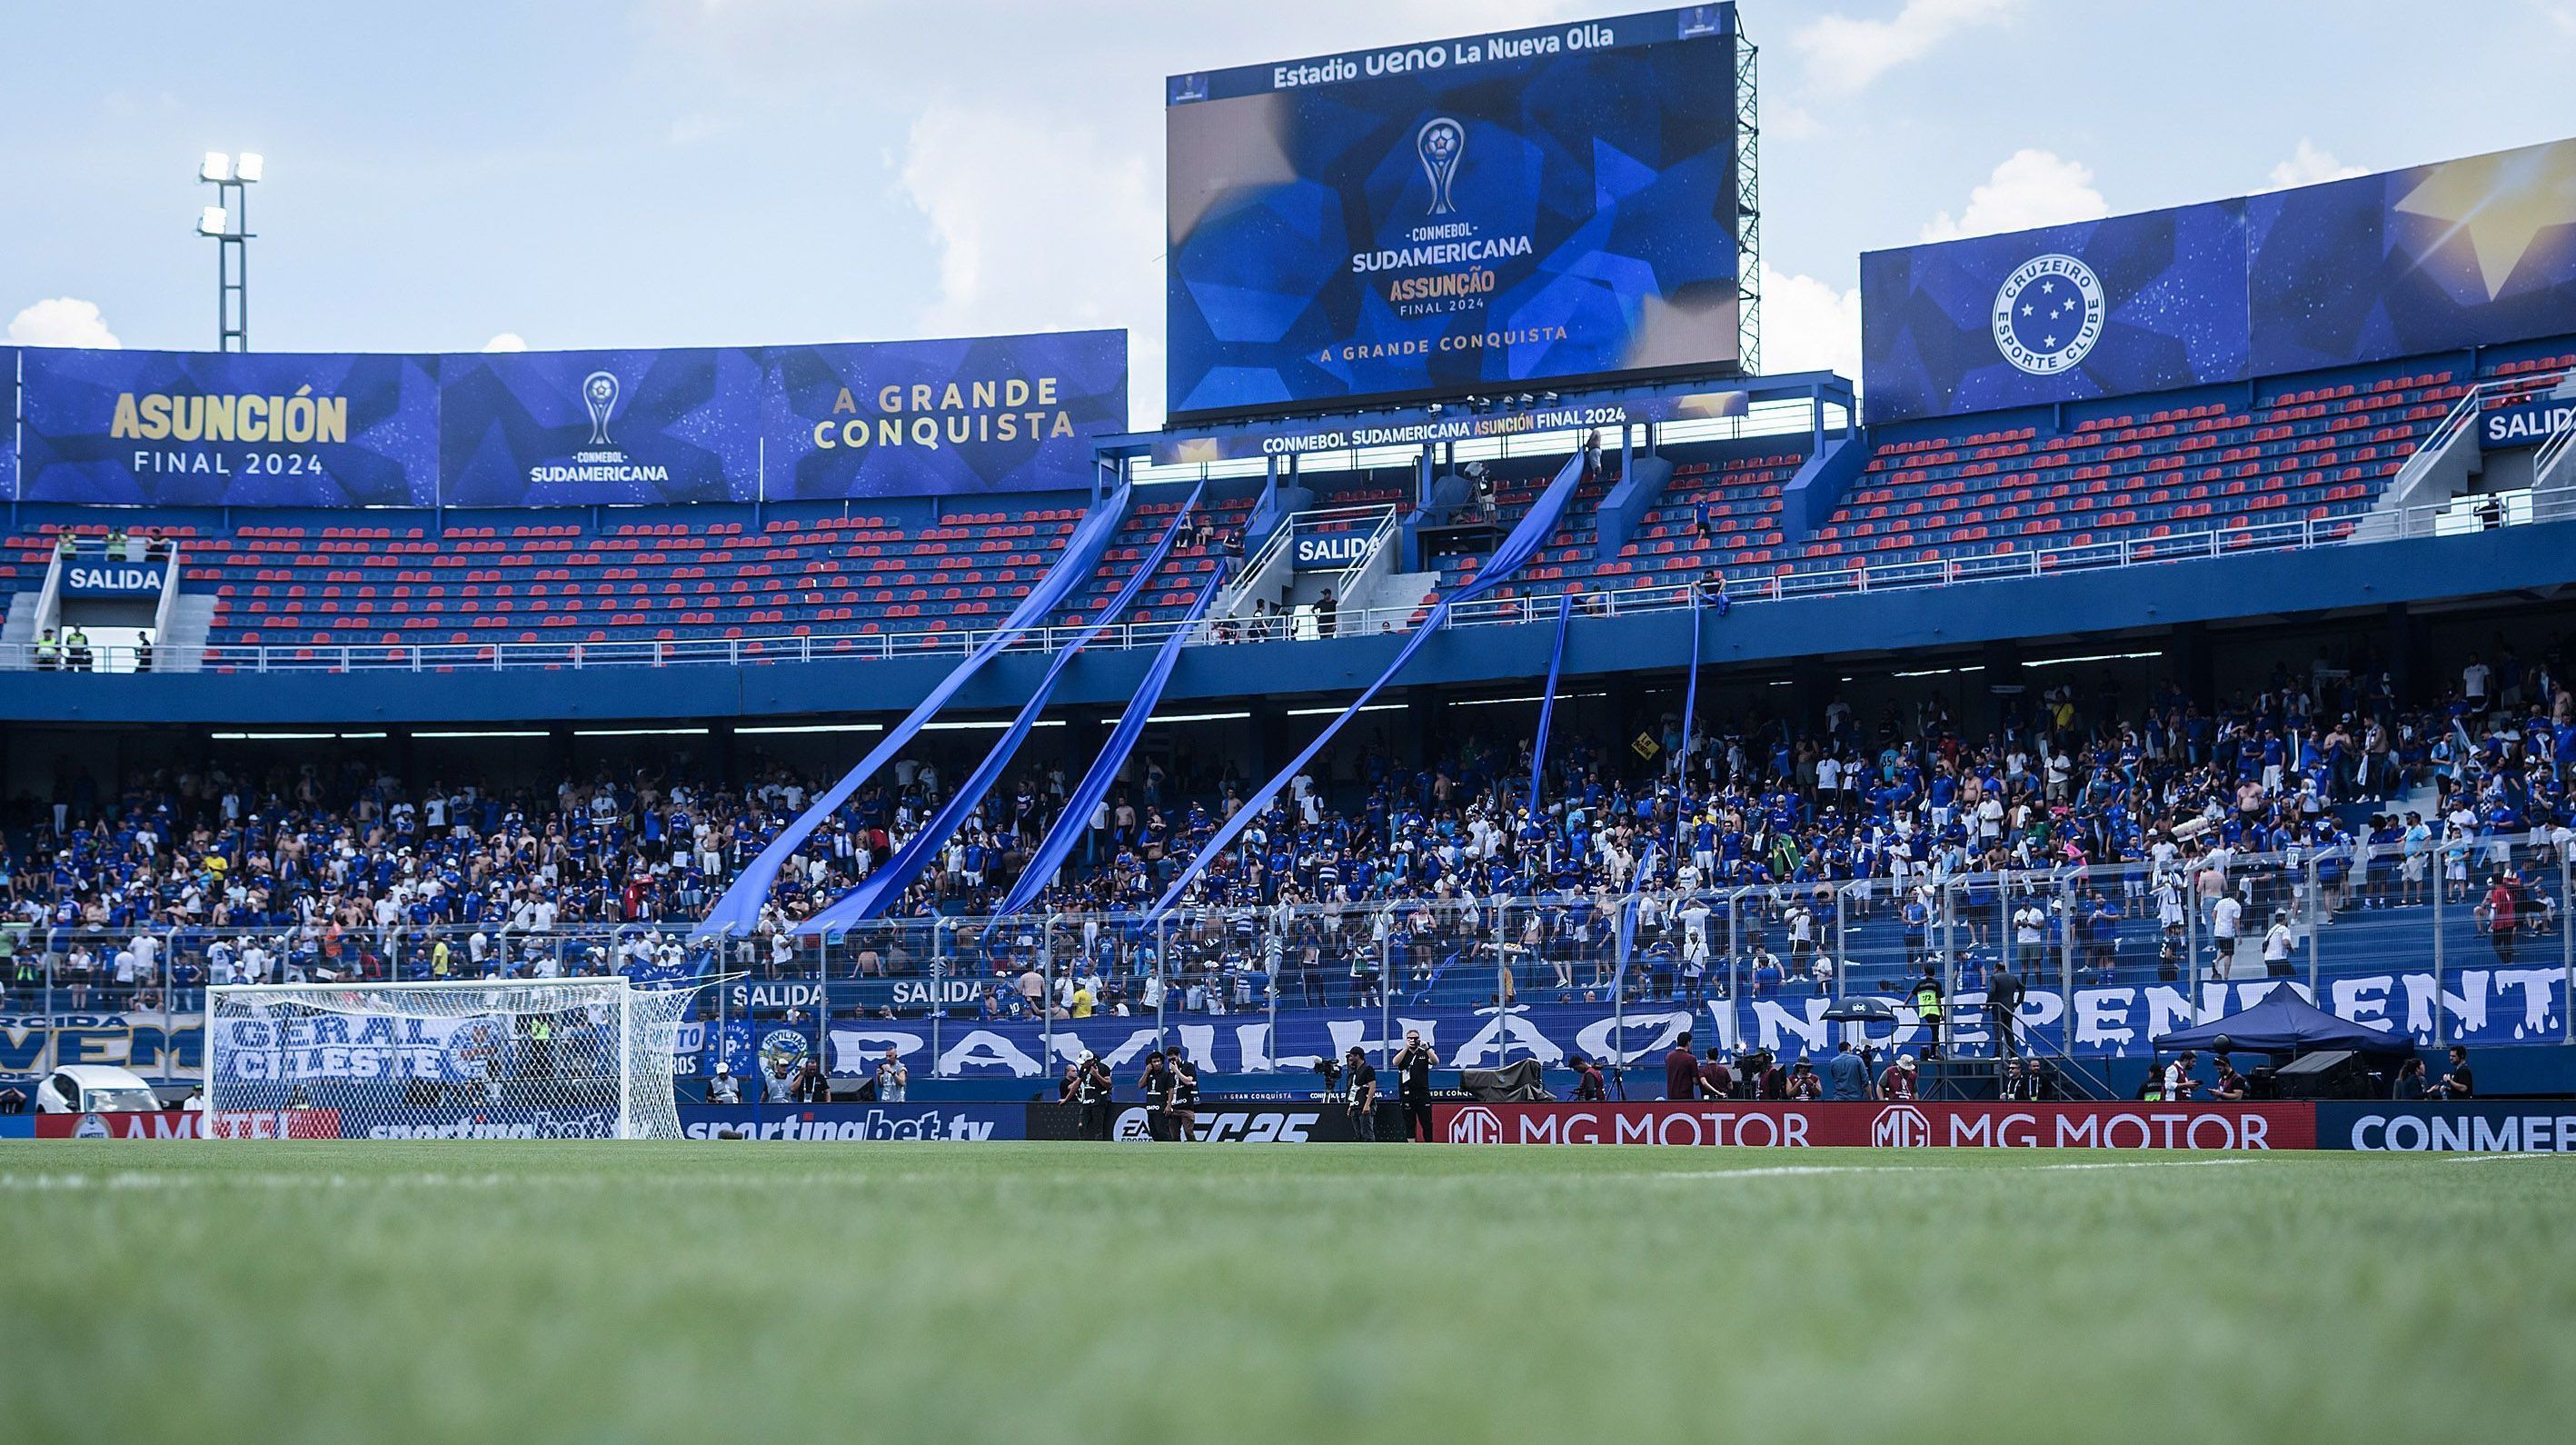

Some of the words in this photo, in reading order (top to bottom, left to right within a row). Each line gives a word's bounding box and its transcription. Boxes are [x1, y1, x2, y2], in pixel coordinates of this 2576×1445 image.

[1273, 58, 1358, 88] Estadio
[1455, 43, 1481, 65] La
[1487, 36, 1560, 61] Nueva
[1567, 25, 1615, 50] Olla
[1352, 235, 1532, 274] SUDAMERICANA
[1390, 265, 1495, 302] ASSUNÇÃO
[2005, 260, 2091, 299] CRUZEIRO
[1400, 303, 1442, 316] FINAL
[1450, 299, 1484, 312] 2024
[1321, 349, 1332, 362] A
[1343, 339, 1429, 360] GRANDE
[1440, 326, 1567, 351] CONQUISTA
[1998, 312, 2058, 369] ESPORTE
[2065, 297, 2099, 360] CLUBE
[110, 384, 347, 443] ASUNCIÓN
[832, 387, 855, 414] A
[879, 377, 1058, 411] GRANDE
[814, 411, 1075, 450] CONQUISTA
[1262, 434, 1348, 453] CONMEBOL
[1351, 424, 1470, 446] SUDAMERICANA
[1474, 413, 1535, 436] ASUNCIÓN
[1537, 411, 1581, 429] FINAL
[1585, 406, 1626, 426] 2024
[2489, 407, 2576, 441] SALID
[134, 451, 230, 475] FINAL
[247, 453, 323, 475] 2024
[530, 465, 669, 483] SUDAMERICANA
[1299, 537, 1379, 562] SALIDA
[69, 568, 162, 590] SALIDA
[733, 985, 822, 1007] SALIDA
[892, 981, 981, 1003] SALIDA
[1123, 1120, 1150, 1136] EA
[1453, 1111, 1499, 1144] MG
[1520, 1112, 1598, 1145] MG
[1616, 1112, 1810, 1147] MOTOR
[1876, 1110, 1926, 1148] MG
[1950, 1113, 2037, 1148] MG
[2056, 1114, 2270, 1150] MOTOR
